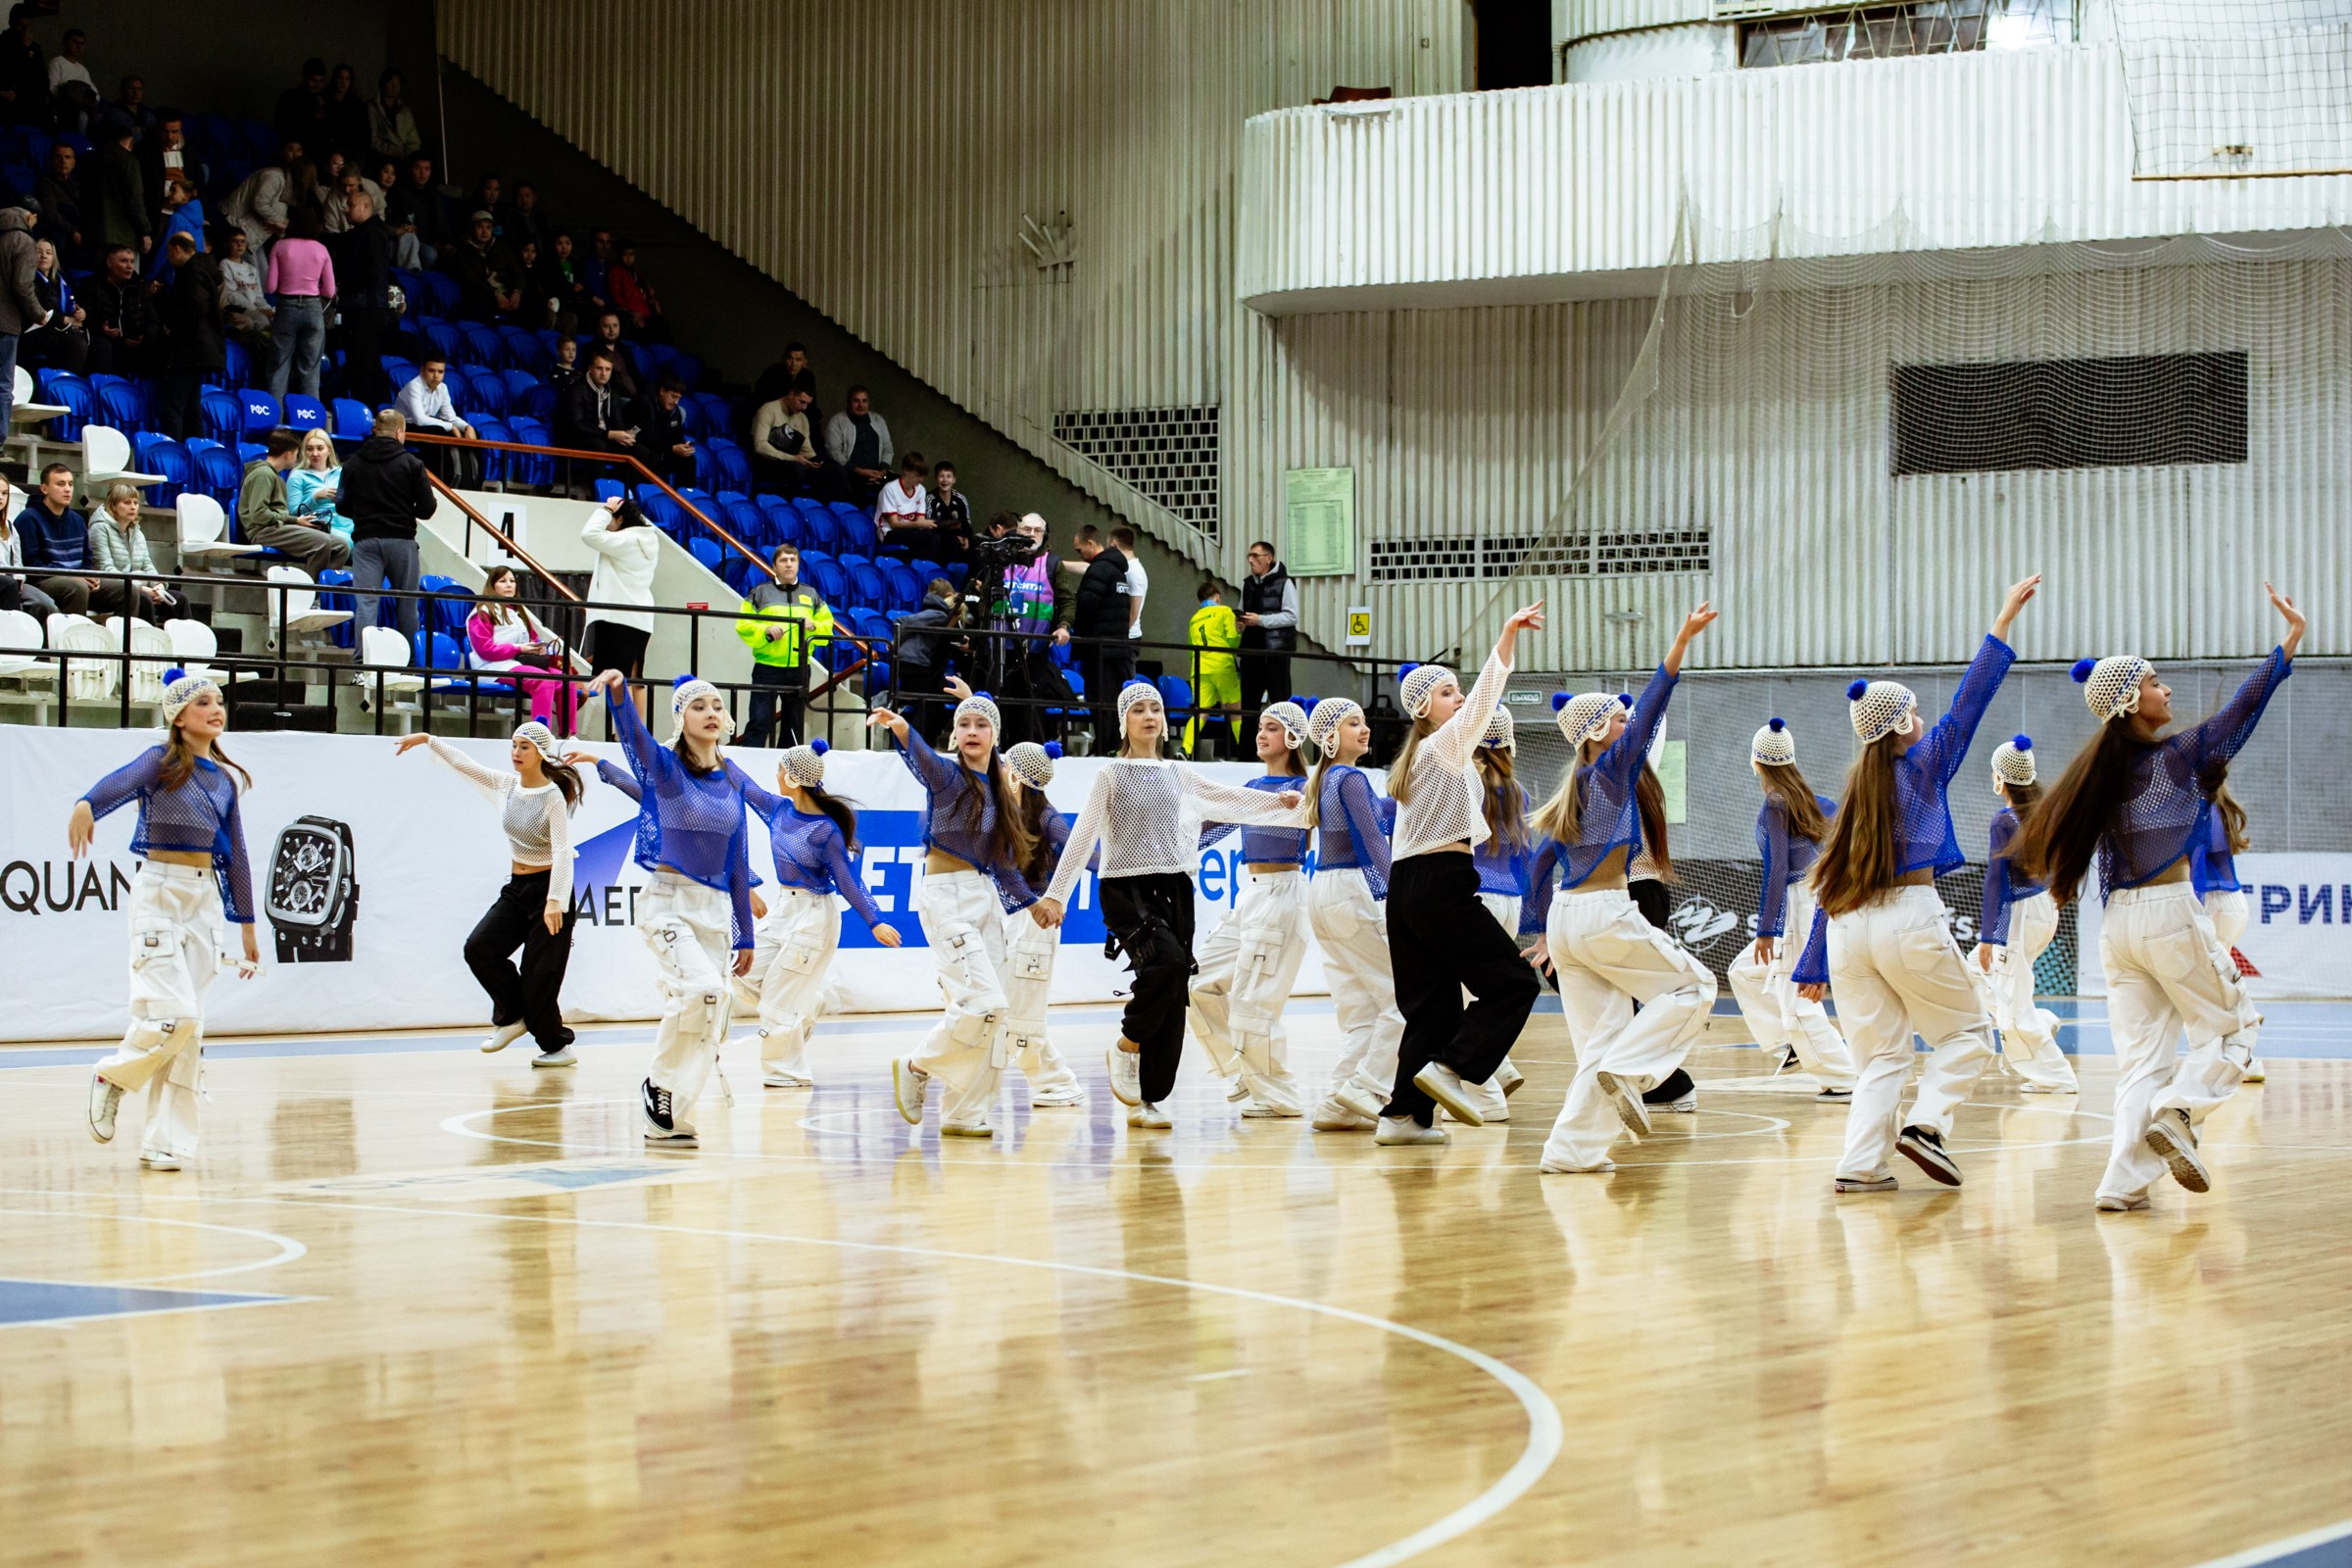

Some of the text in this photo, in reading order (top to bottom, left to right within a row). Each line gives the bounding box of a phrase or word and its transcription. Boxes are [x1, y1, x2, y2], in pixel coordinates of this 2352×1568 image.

[250, 404, 270, 416] РФС
[296, 409, 317, 419] РФС
[498, 512, 514, 559] 4
